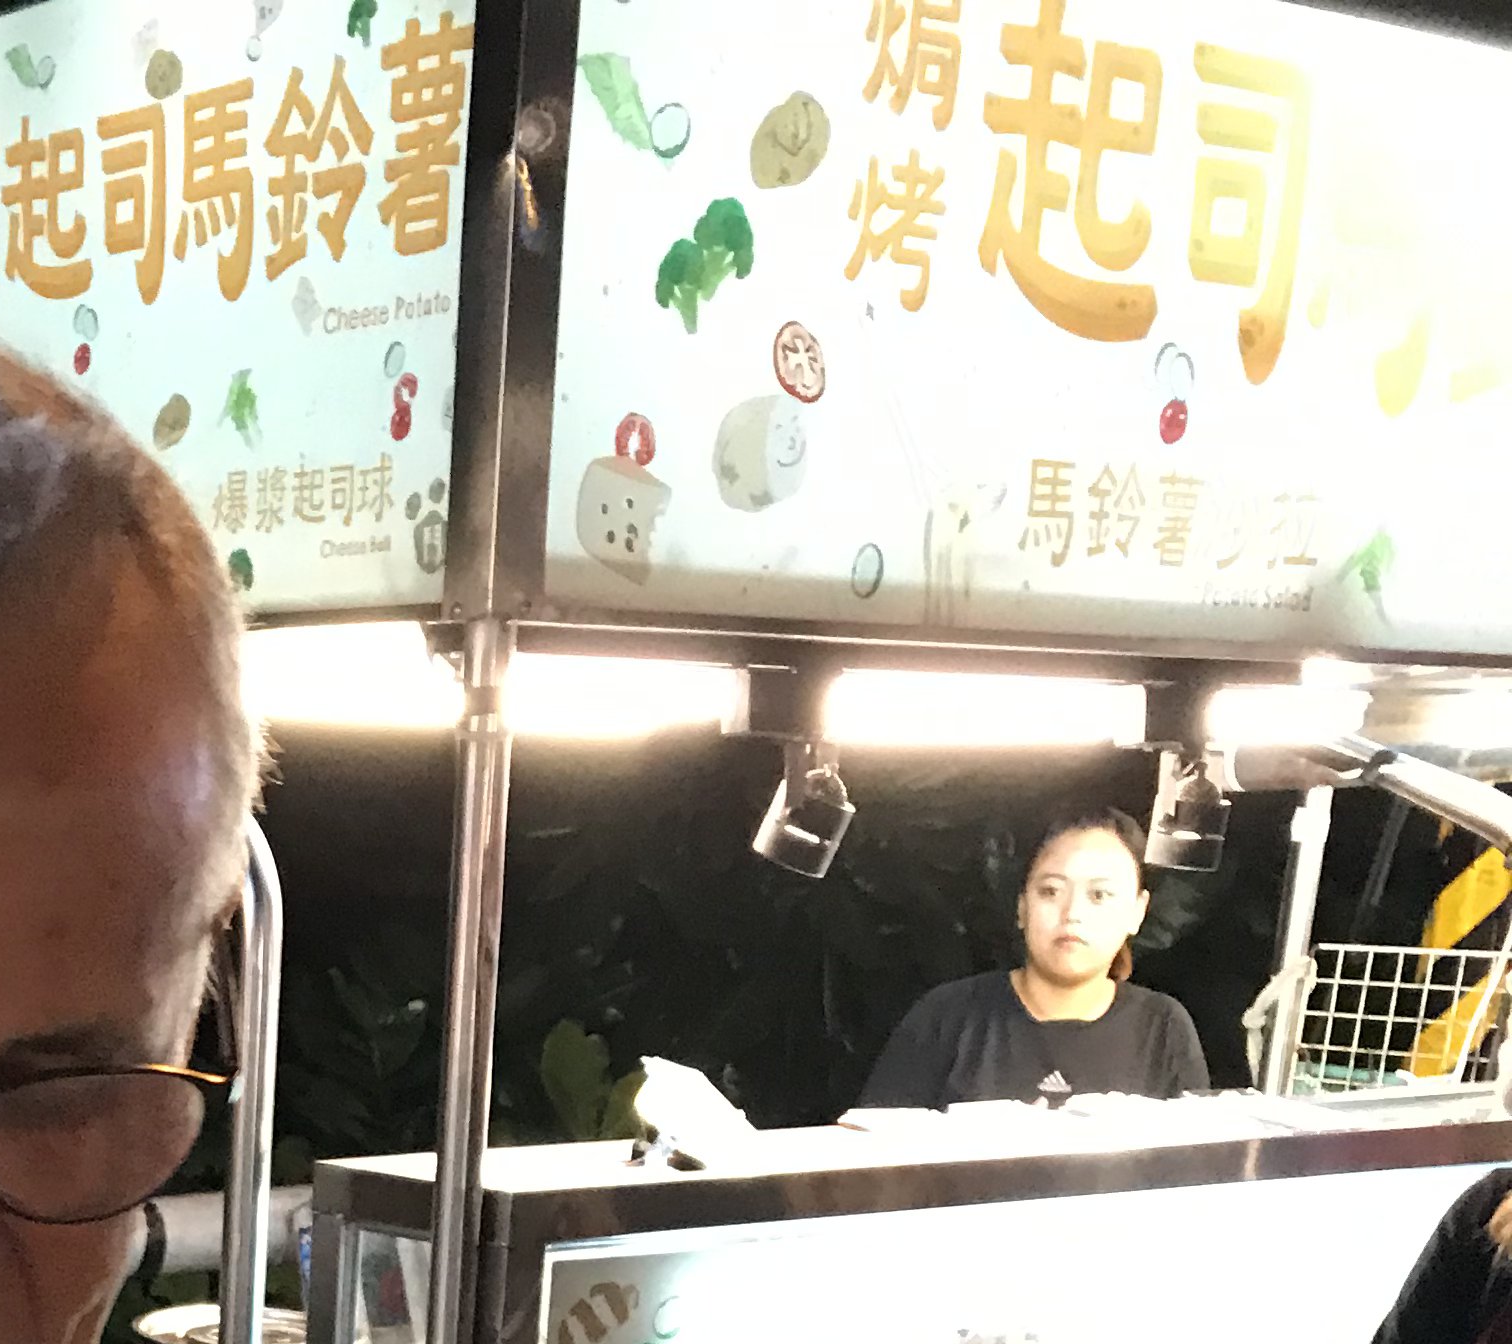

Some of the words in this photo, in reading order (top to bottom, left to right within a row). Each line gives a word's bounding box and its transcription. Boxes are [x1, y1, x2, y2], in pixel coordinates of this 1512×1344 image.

[1, 11, 475, 305] 起司馬鈴薯
[323, 305, 389, 334] Cheese
[394, 290, 452, 320] Potato
[212, 452, 394, 534] 爆漿起司球
